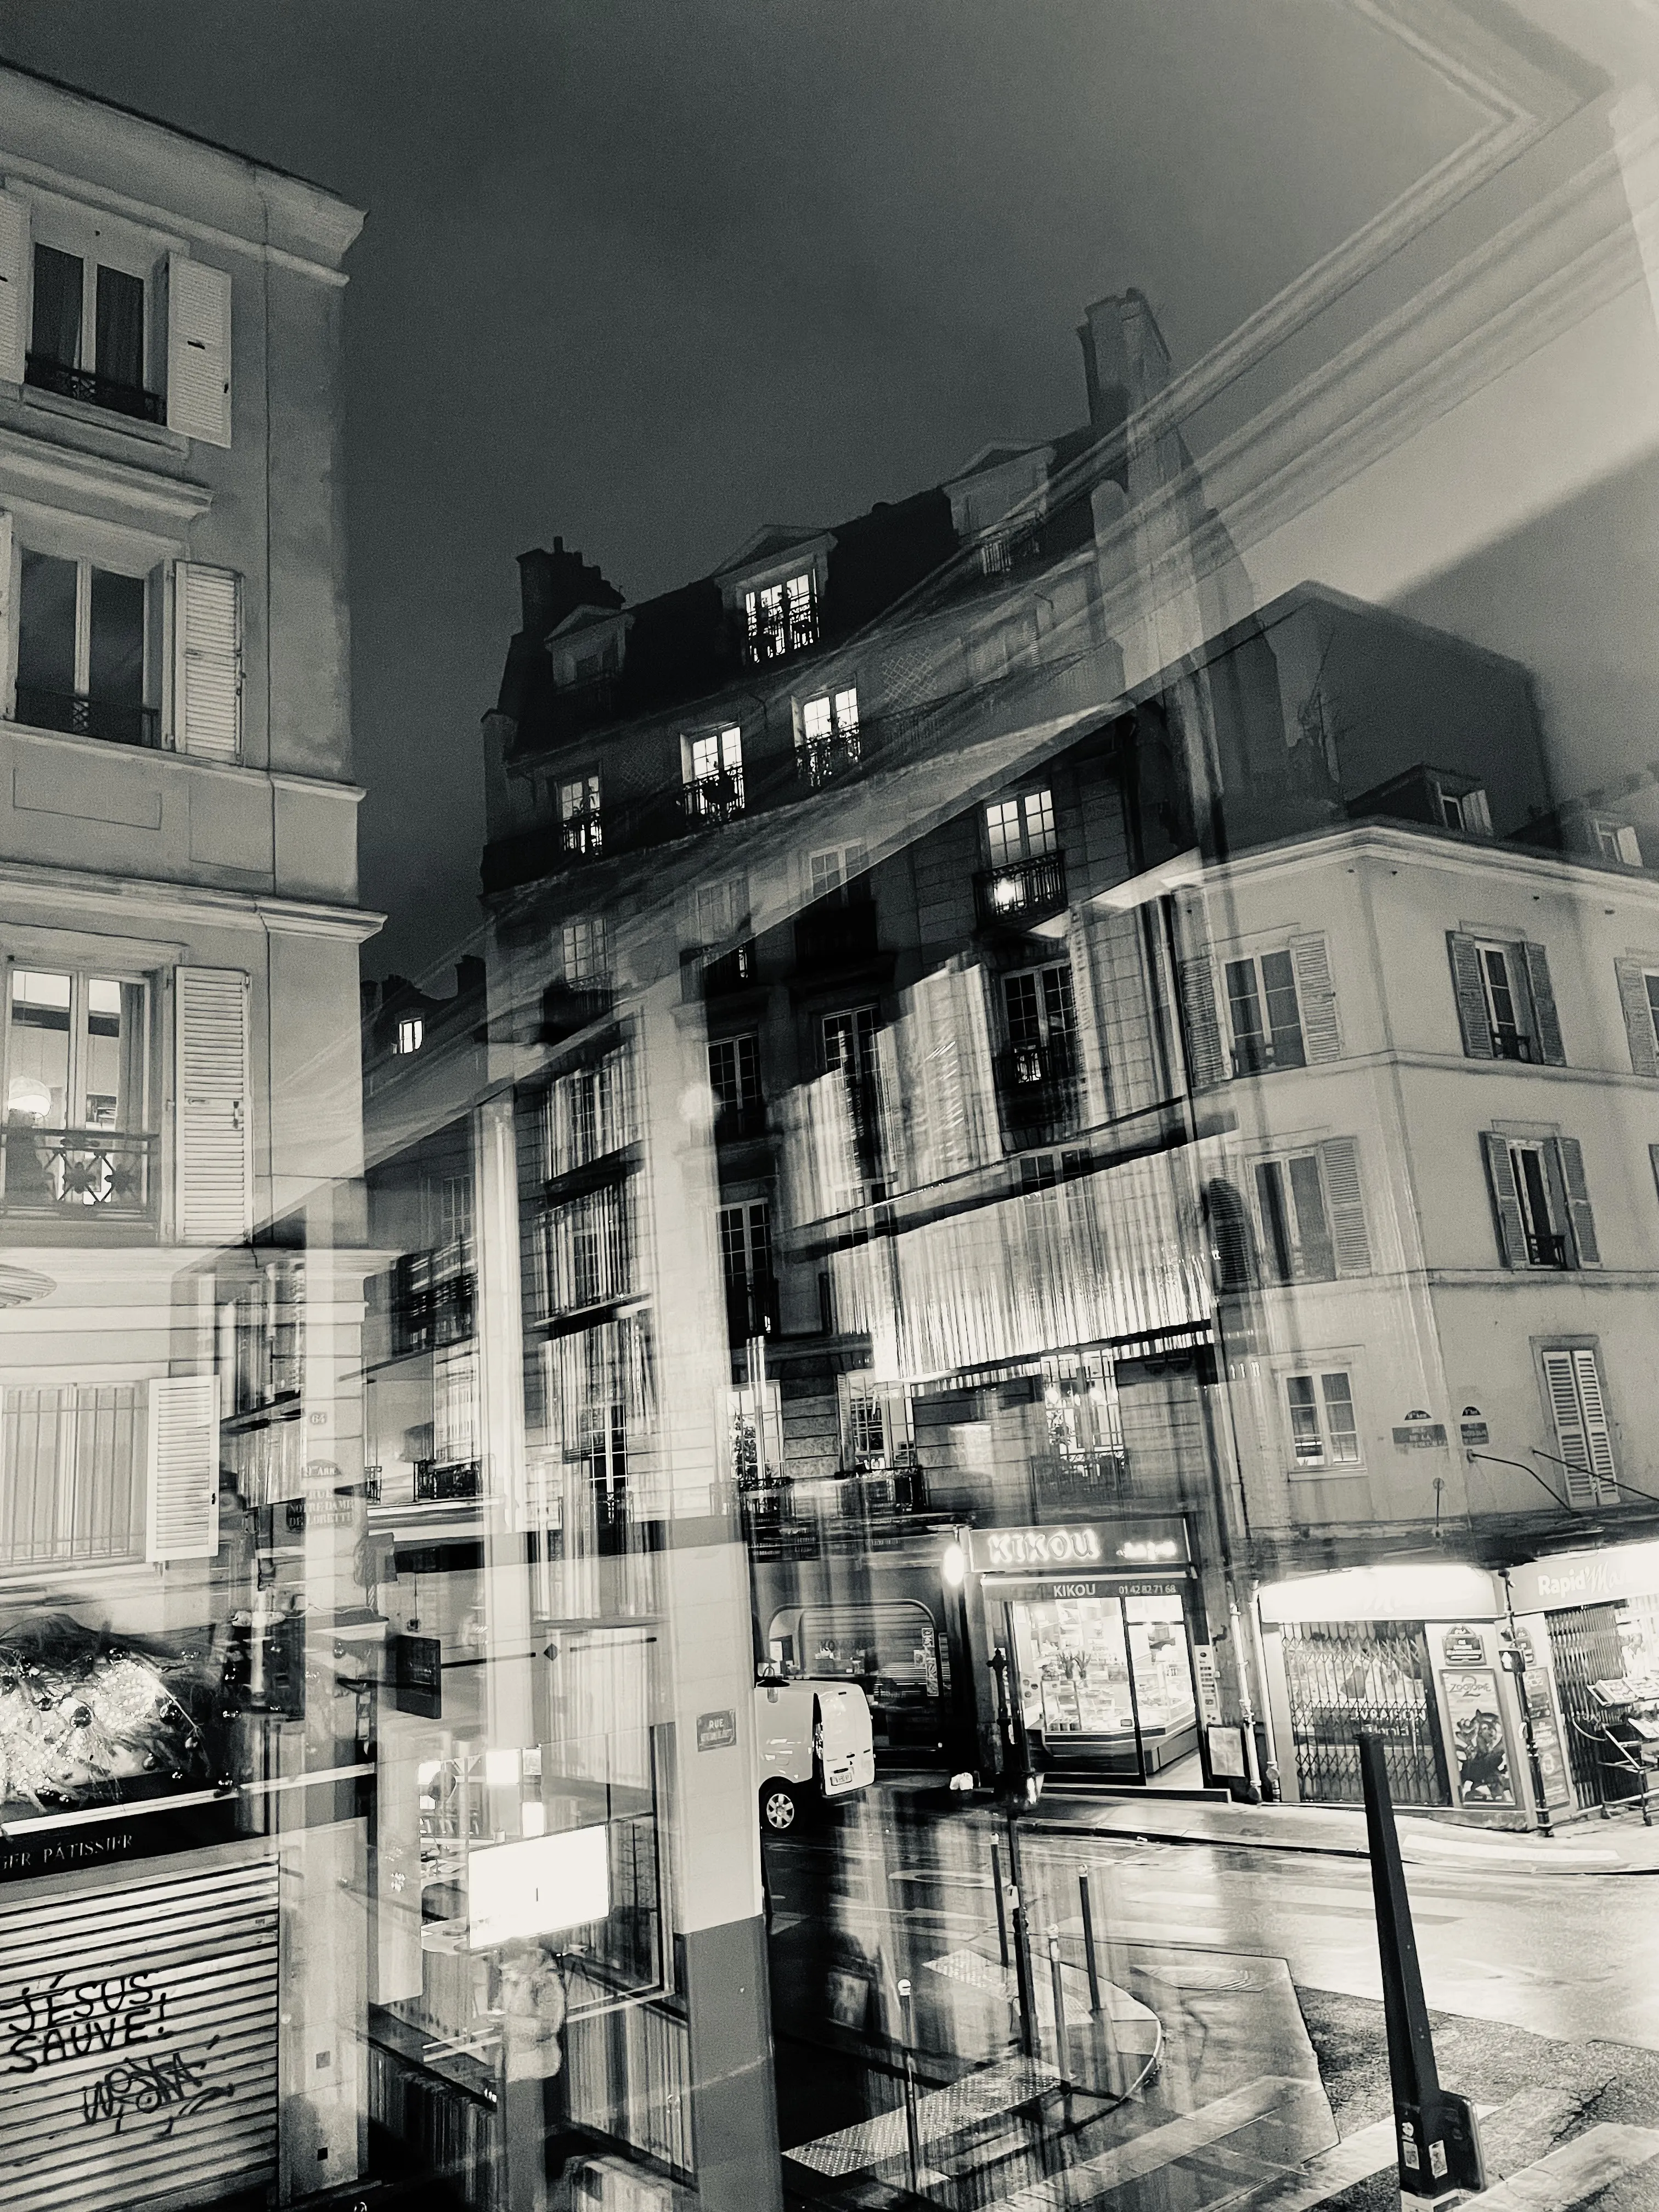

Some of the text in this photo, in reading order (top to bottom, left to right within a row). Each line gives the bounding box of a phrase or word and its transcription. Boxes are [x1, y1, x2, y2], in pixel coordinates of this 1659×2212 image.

[989, 1529, 1099, 1563] KIKOU
[1053, 1584, 1176, 1597] KIKOU 01 42 82 71 68
[709, 1718, 724, 1729] RUE
